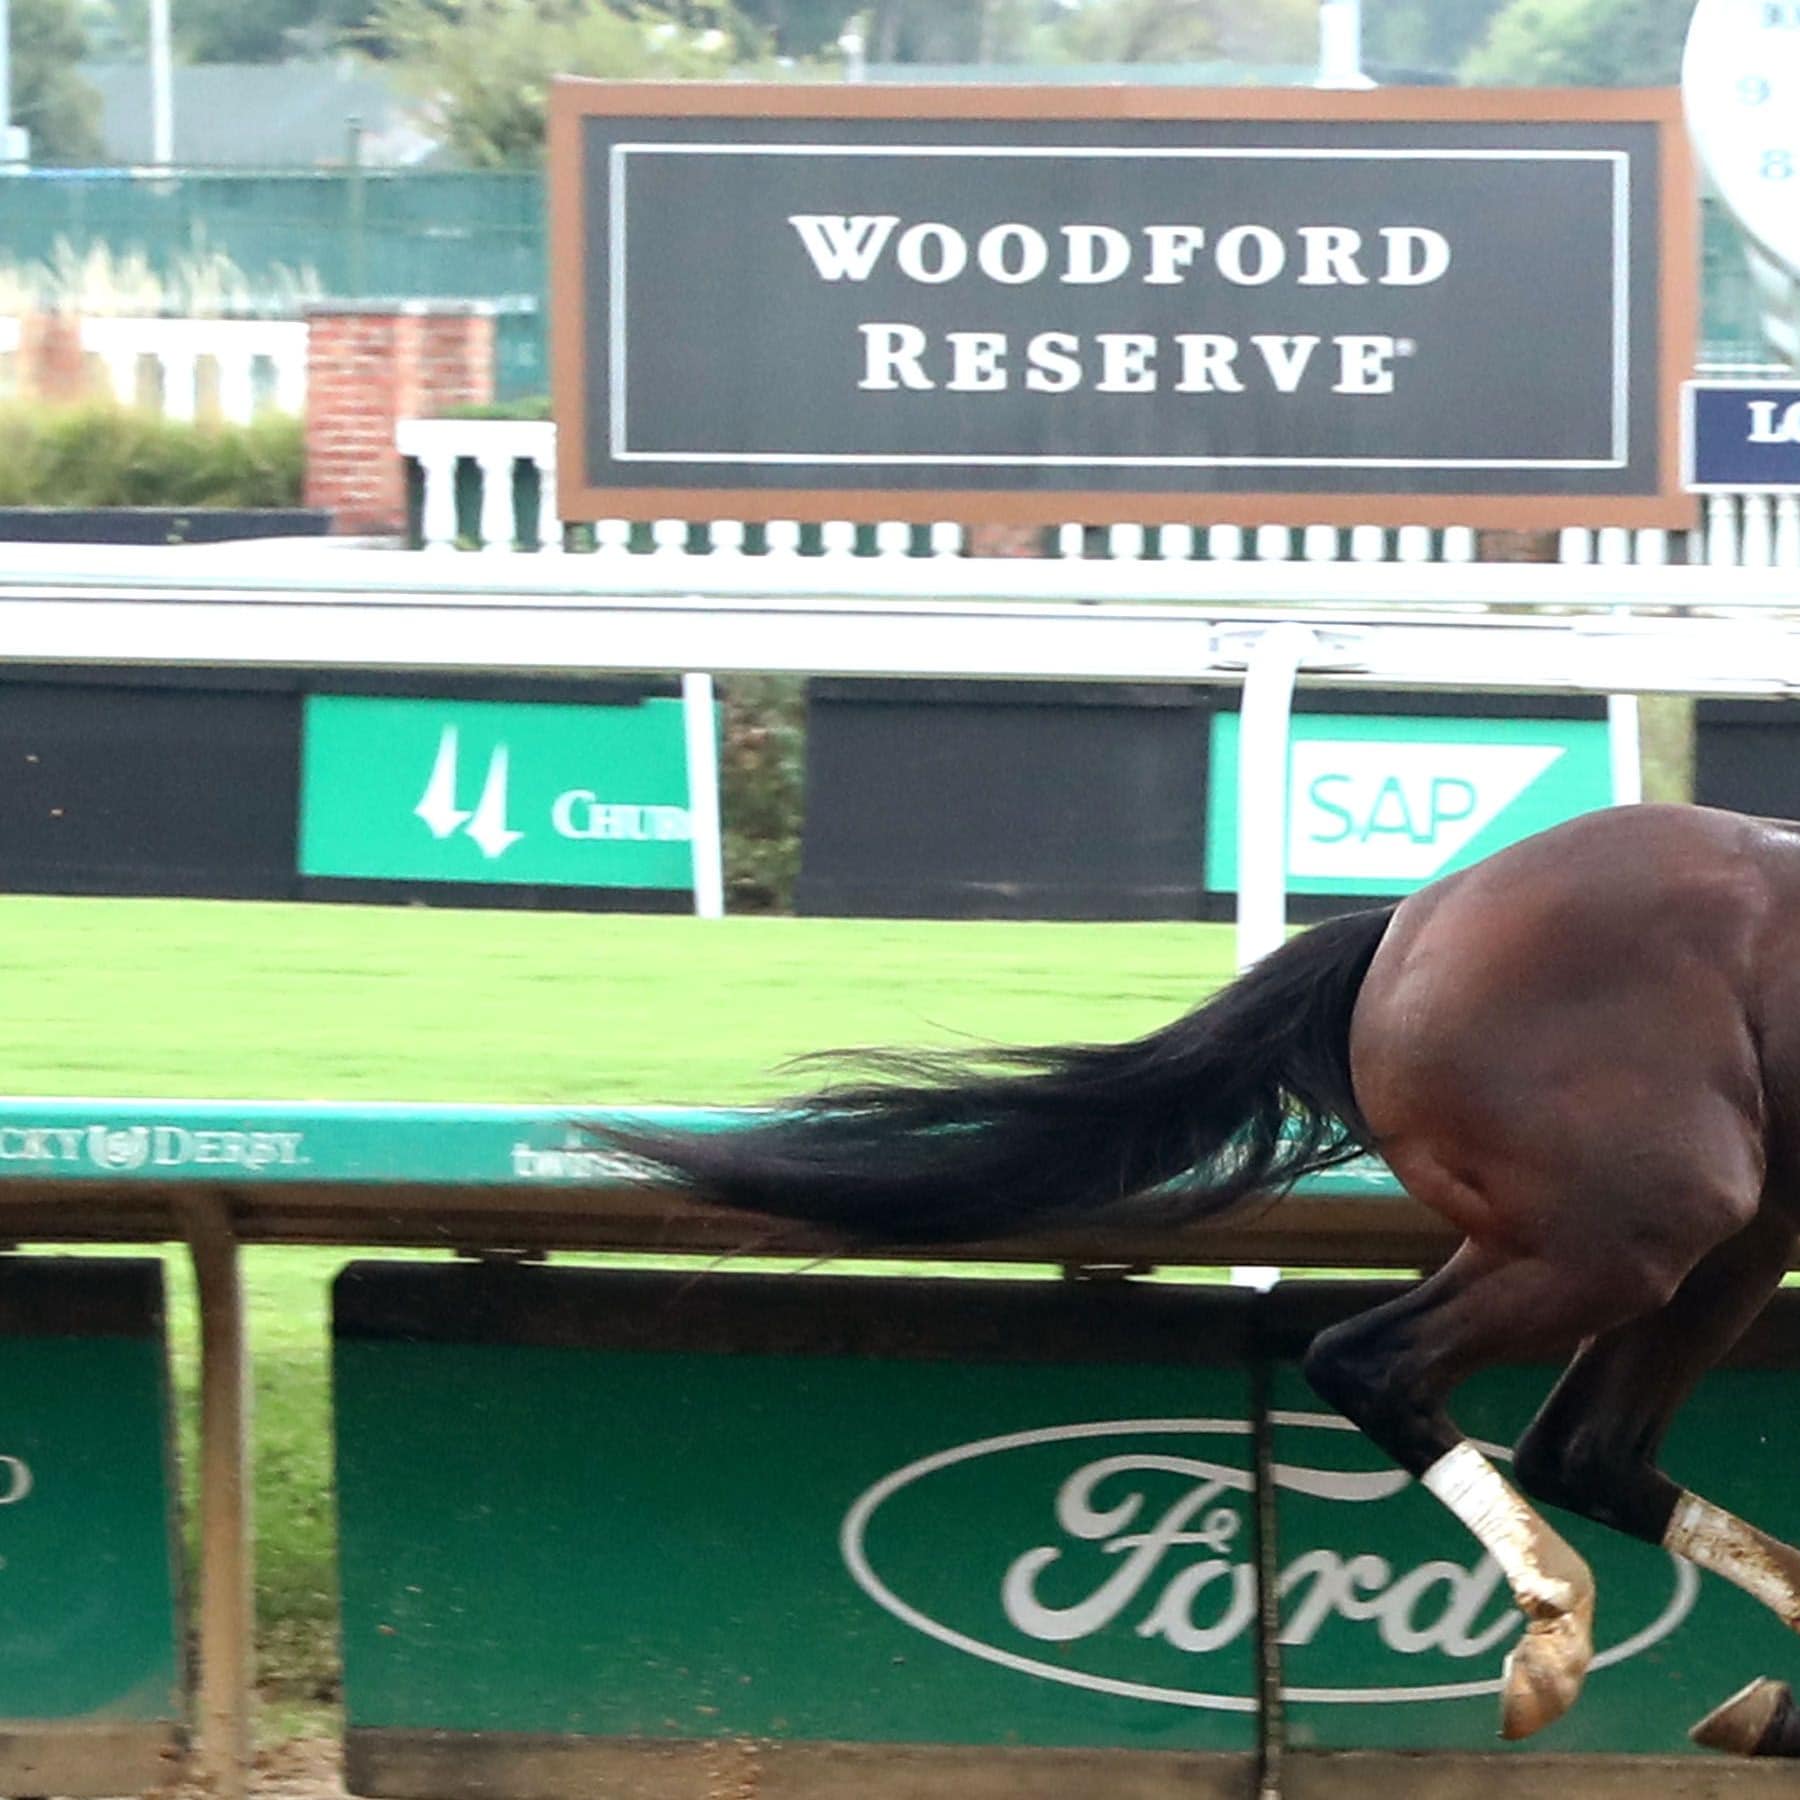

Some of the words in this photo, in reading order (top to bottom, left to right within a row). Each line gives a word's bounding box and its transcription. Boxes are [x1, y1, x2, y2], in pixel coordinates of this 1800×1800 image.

[1758, 149, 1797, 181] 8
[787, 215, 1452, 286] WOODFORD
[1308, 773, 1478, 845] SAP
[1003, 1454, 1523, 1657] Ford
